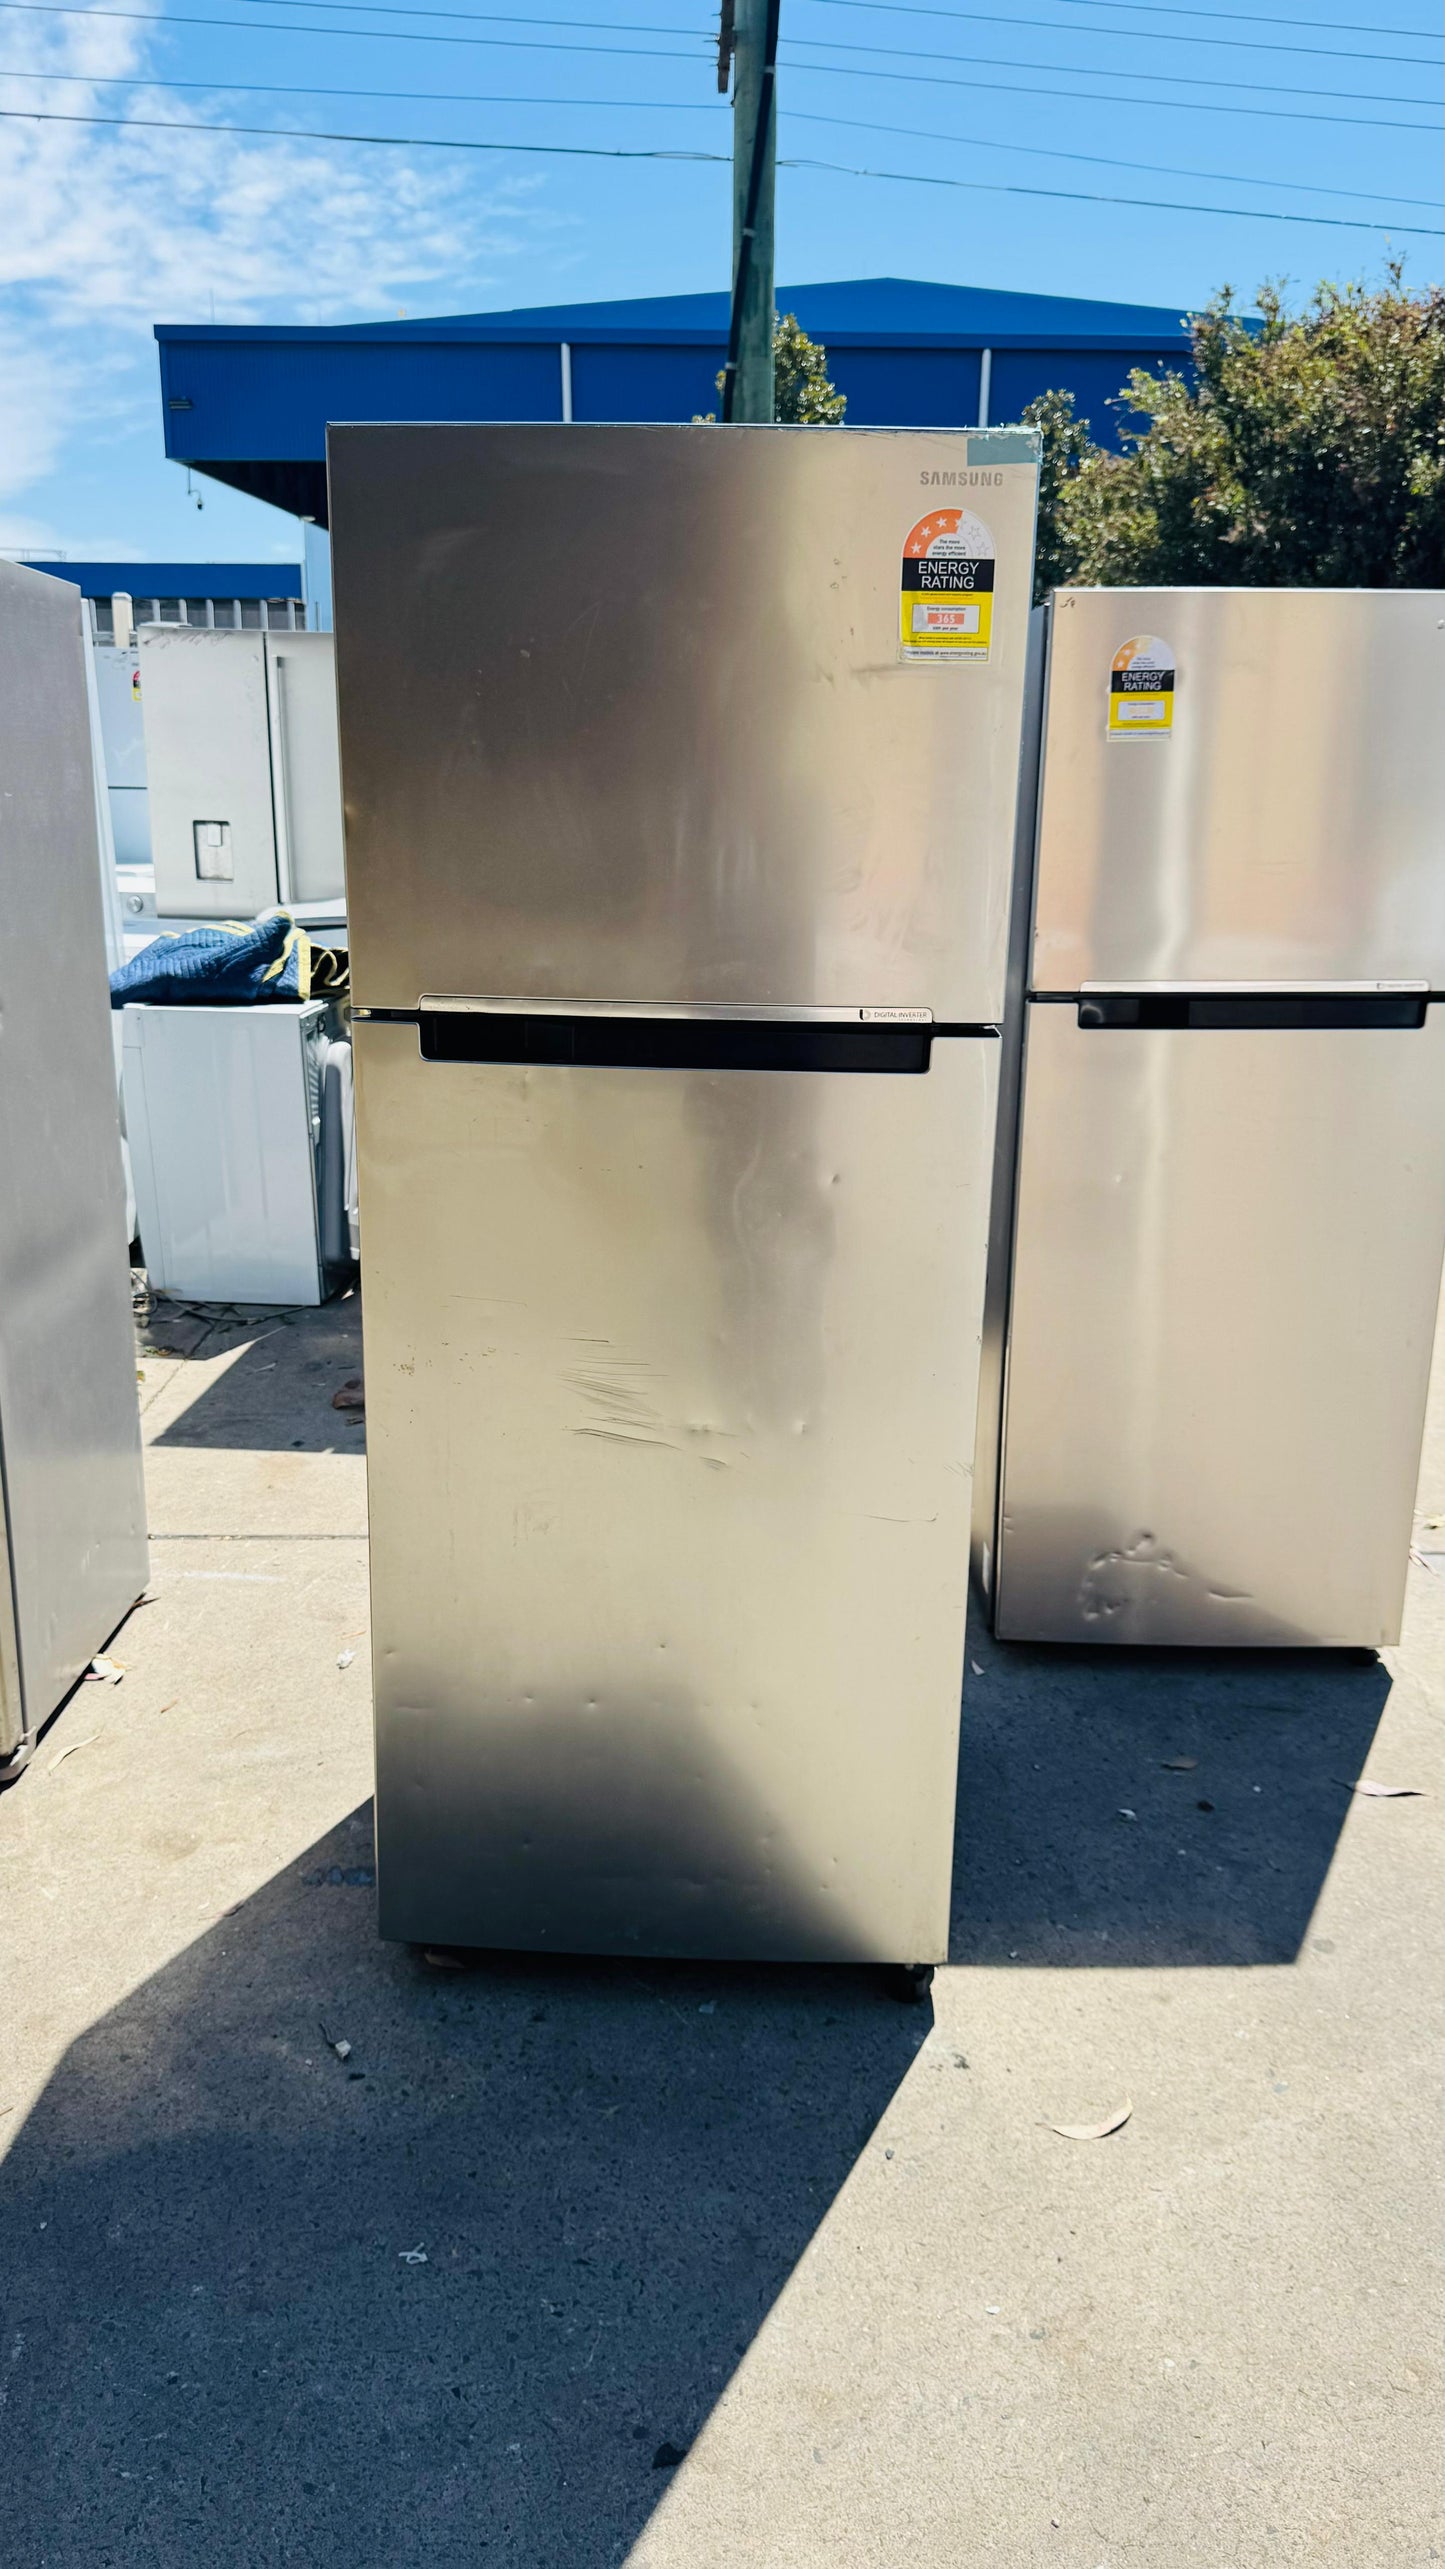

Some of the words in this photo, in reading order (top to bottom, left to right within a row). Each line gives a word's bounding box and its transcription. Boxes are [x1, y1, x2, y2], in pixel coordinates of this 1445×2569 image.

[920, 471, 1003, 486] SAMSUNG
[918, 561, 980, 575] ENERGY
[921, 575, 975, 589] RATING
[937, 614, 955, 624] 365
[1121, 672, 1165, 681] ENERGY
[1123, 682, 1162, 691] RATING
